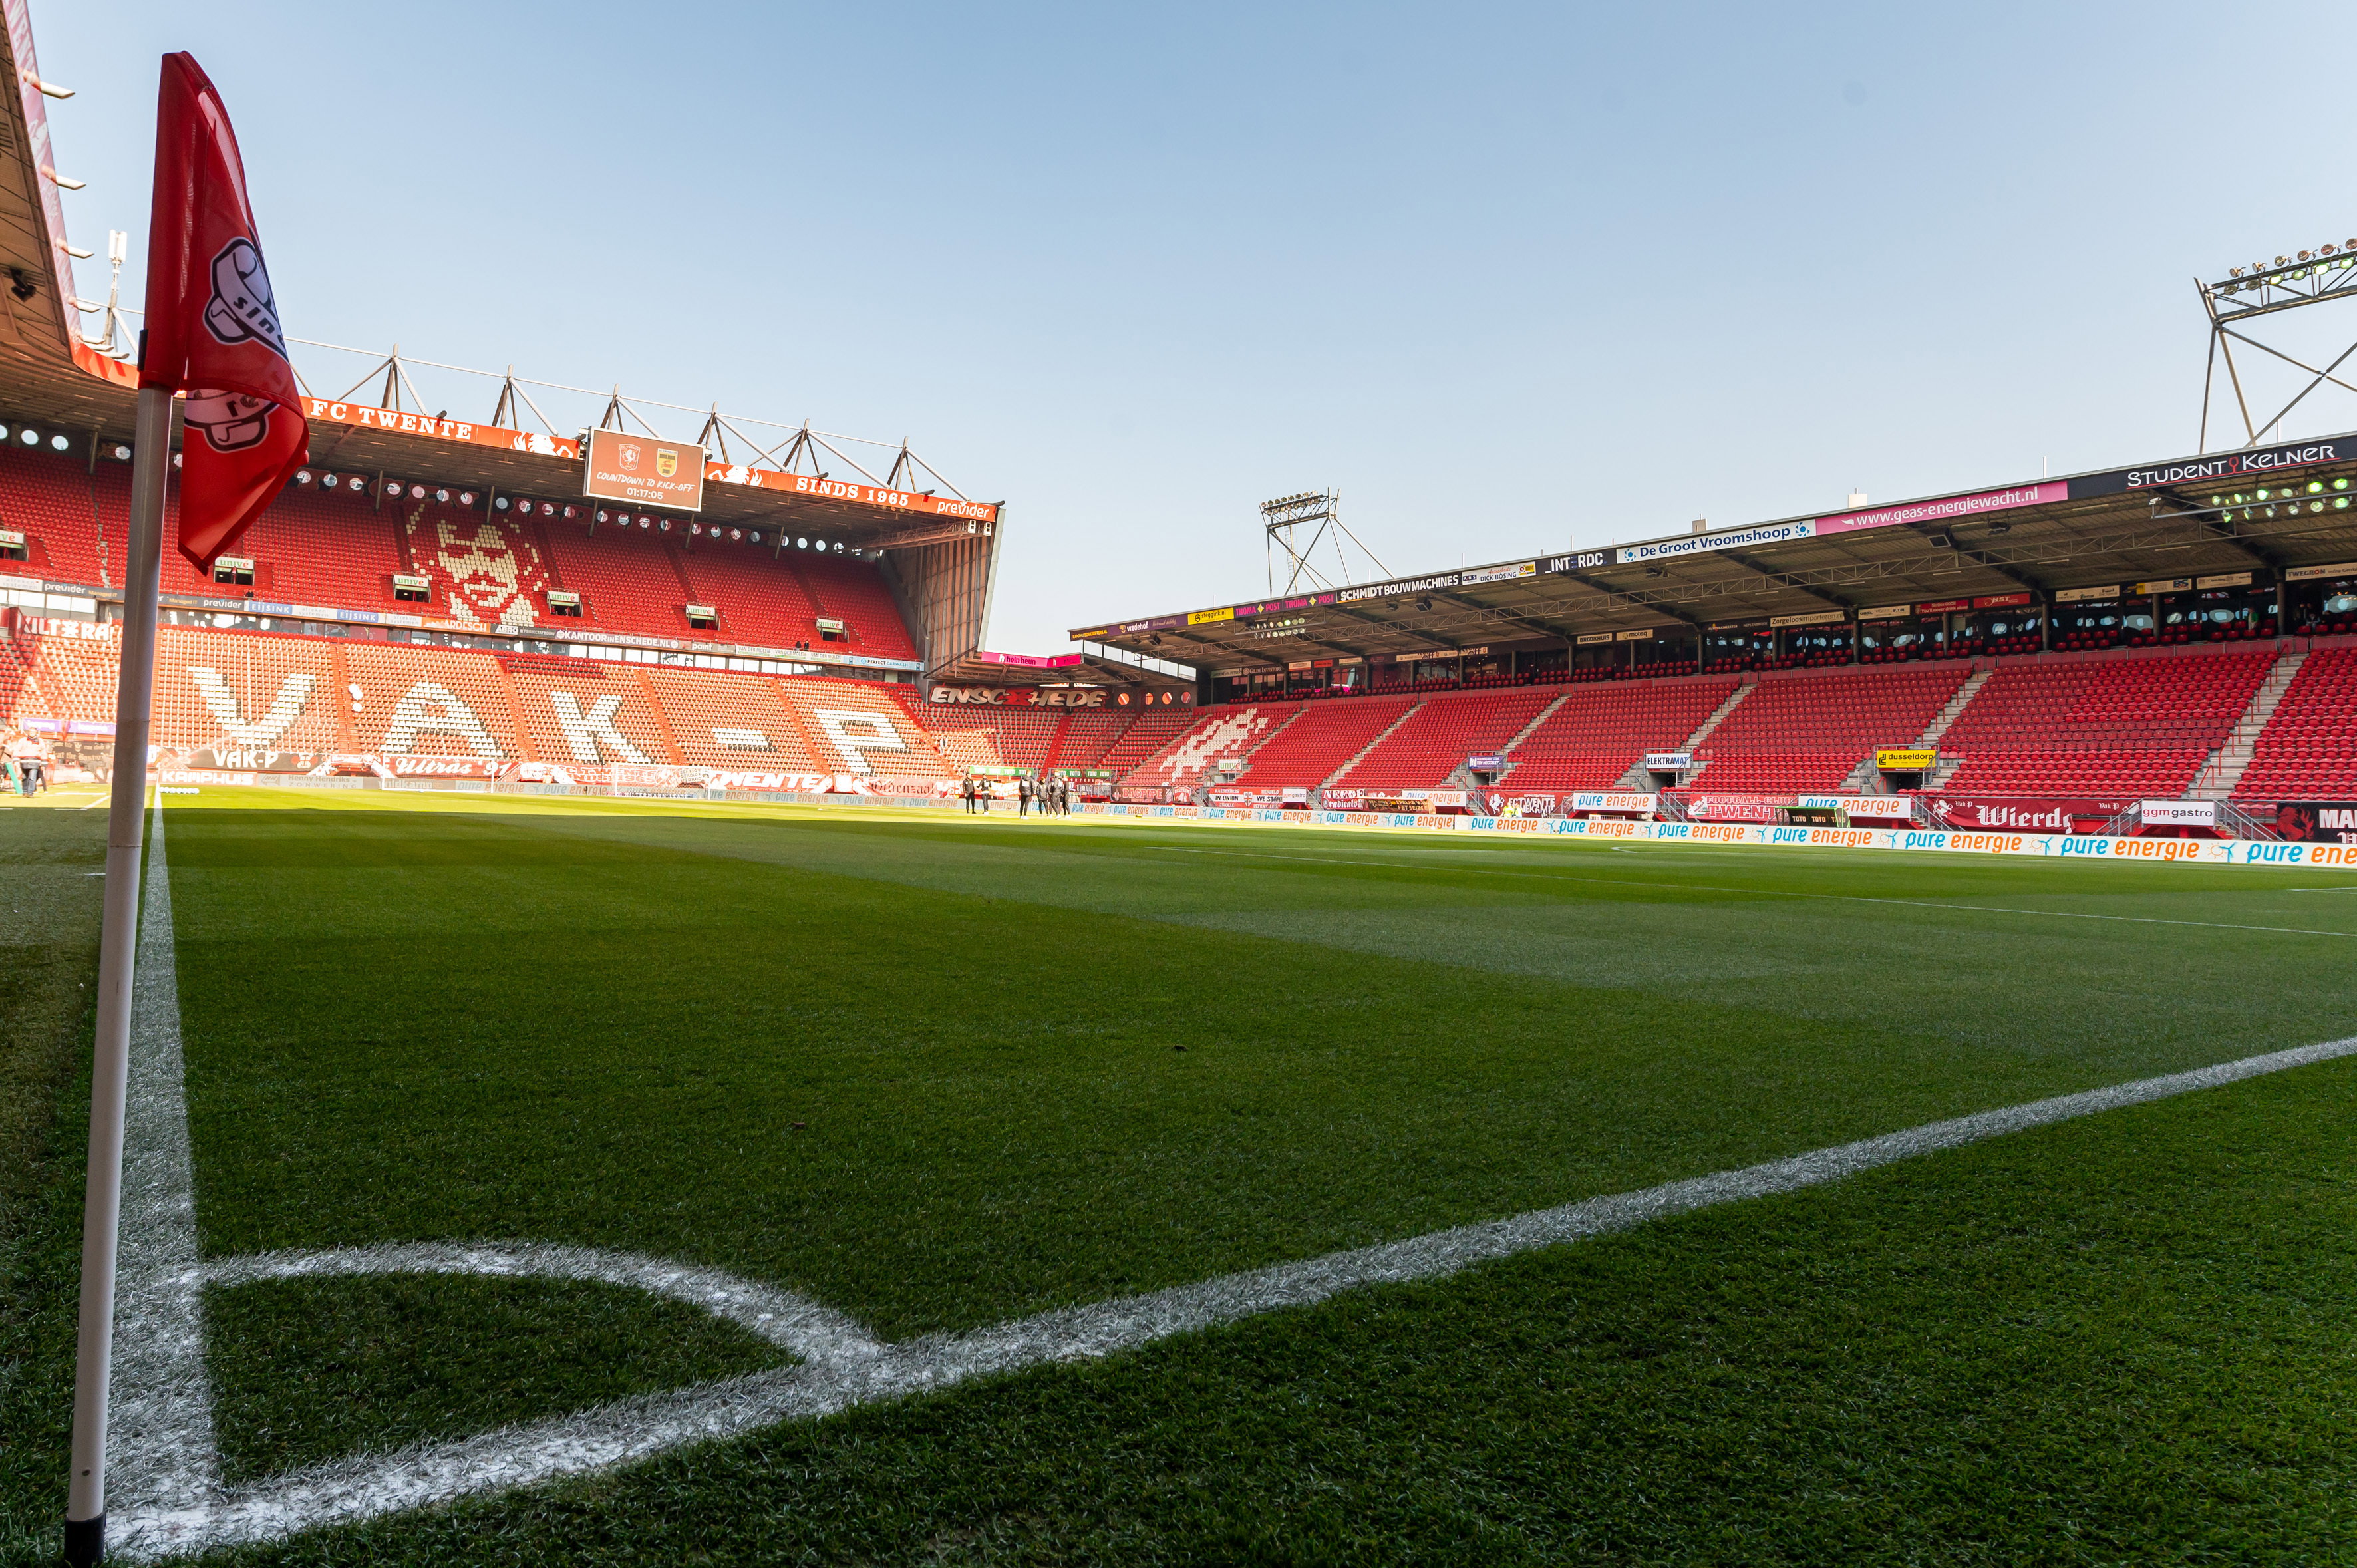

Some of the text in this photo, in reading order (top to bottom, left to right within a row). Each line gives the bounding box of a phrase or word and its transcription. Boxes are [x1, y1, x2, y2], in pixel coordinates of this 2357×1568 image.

[311, 399, 472, 440] FC TWENTE
[597, 471, 695, 492] COUNTDOWN TO KICK-OFF
[627, 488, 663, 500] 01:17:05
[796, 477, 909, 506] SINDS 1965
[937, 500, 990, 518] previder
[1856, 486, 2038, 526] www.geas-energiewacht.nl
[1640, 526, 1790, 558] De Groot Vroomshoop
[220, 559, 249, 569] univé
[1495, 571, 1517, 580] BÖSING
[2288, 569, 2326, 577] TWEGRON
[398, 577, 424, 586] univé
[1340, 574, 1459, 601] SCHMIDT BOUWMACHINES
[45, 583, 86, 595] previder
[551, 593, 575, 601] univé
[204, 599, 242, 609] previder
[1235, 593, 1335, 616] THOMA POST THOMA POST
[1201, 609, 1226, 620] steggink.nl
[496, 625, 518, 634] ABRO
[1126, 621, 1148, 632] vredehof
[1020, 657, 1036, 665] heun
[212, 749, 279, 769] VAK-P
[1647, 756, 1688, 766] ELEKTRAMAT
[1888, 753, 1933, 762] dusseldorp
[395, 757, 472, 775] Ultras
[1220, 759, 1241, 770] univé
[162, 770, 255, 786] KAMPHUIS
[288, 774, 313, 784] Henny
[457, 781, 524, 793] pure energie
[544, 783, 607, 796] pure energie
[725, 791, 759, 801] energie
[775, 793, 829, 804] pure energie
[1122, 788, 1163, 799] BAGPIPE
[1323, 788, 1365, 799] NEEDE
[1428, 792, 1461, 804] energie
[844, 795, 895, 806] pure energie
[909, 797, 958, 808] pure energie
[990, 800, 1018, 810] energie
[1578, 794, 1649, 808] pure energie
[1842, 798, 1900, 815] energie
[1072, 803, 1104, 814] pure energie
[1113, 804, 1149, 815] pure energie
[1159, 806, 1198, 817] pure energie
[1209, 808, 1252, 820] pure energie
[1265, 810, 1311, 824] pure energie
[1326, 812, 1378, 826] pure energie
[1394, 814, 1452, 829] pure energie
[2318, 808, 2357, 829] MA
[1471, 818, 1538, 833] pure energie
[1559, 820, 1634, 836] pure energie
[1658, 823, 1745, 842] pure energie
[1772, 828, 1873, 847] pure energie
[1905, 832, 2022, 854] pure energie
[2060, 837, 2200, 861] pure energie
[2247, 843, 2303, 864] pure
